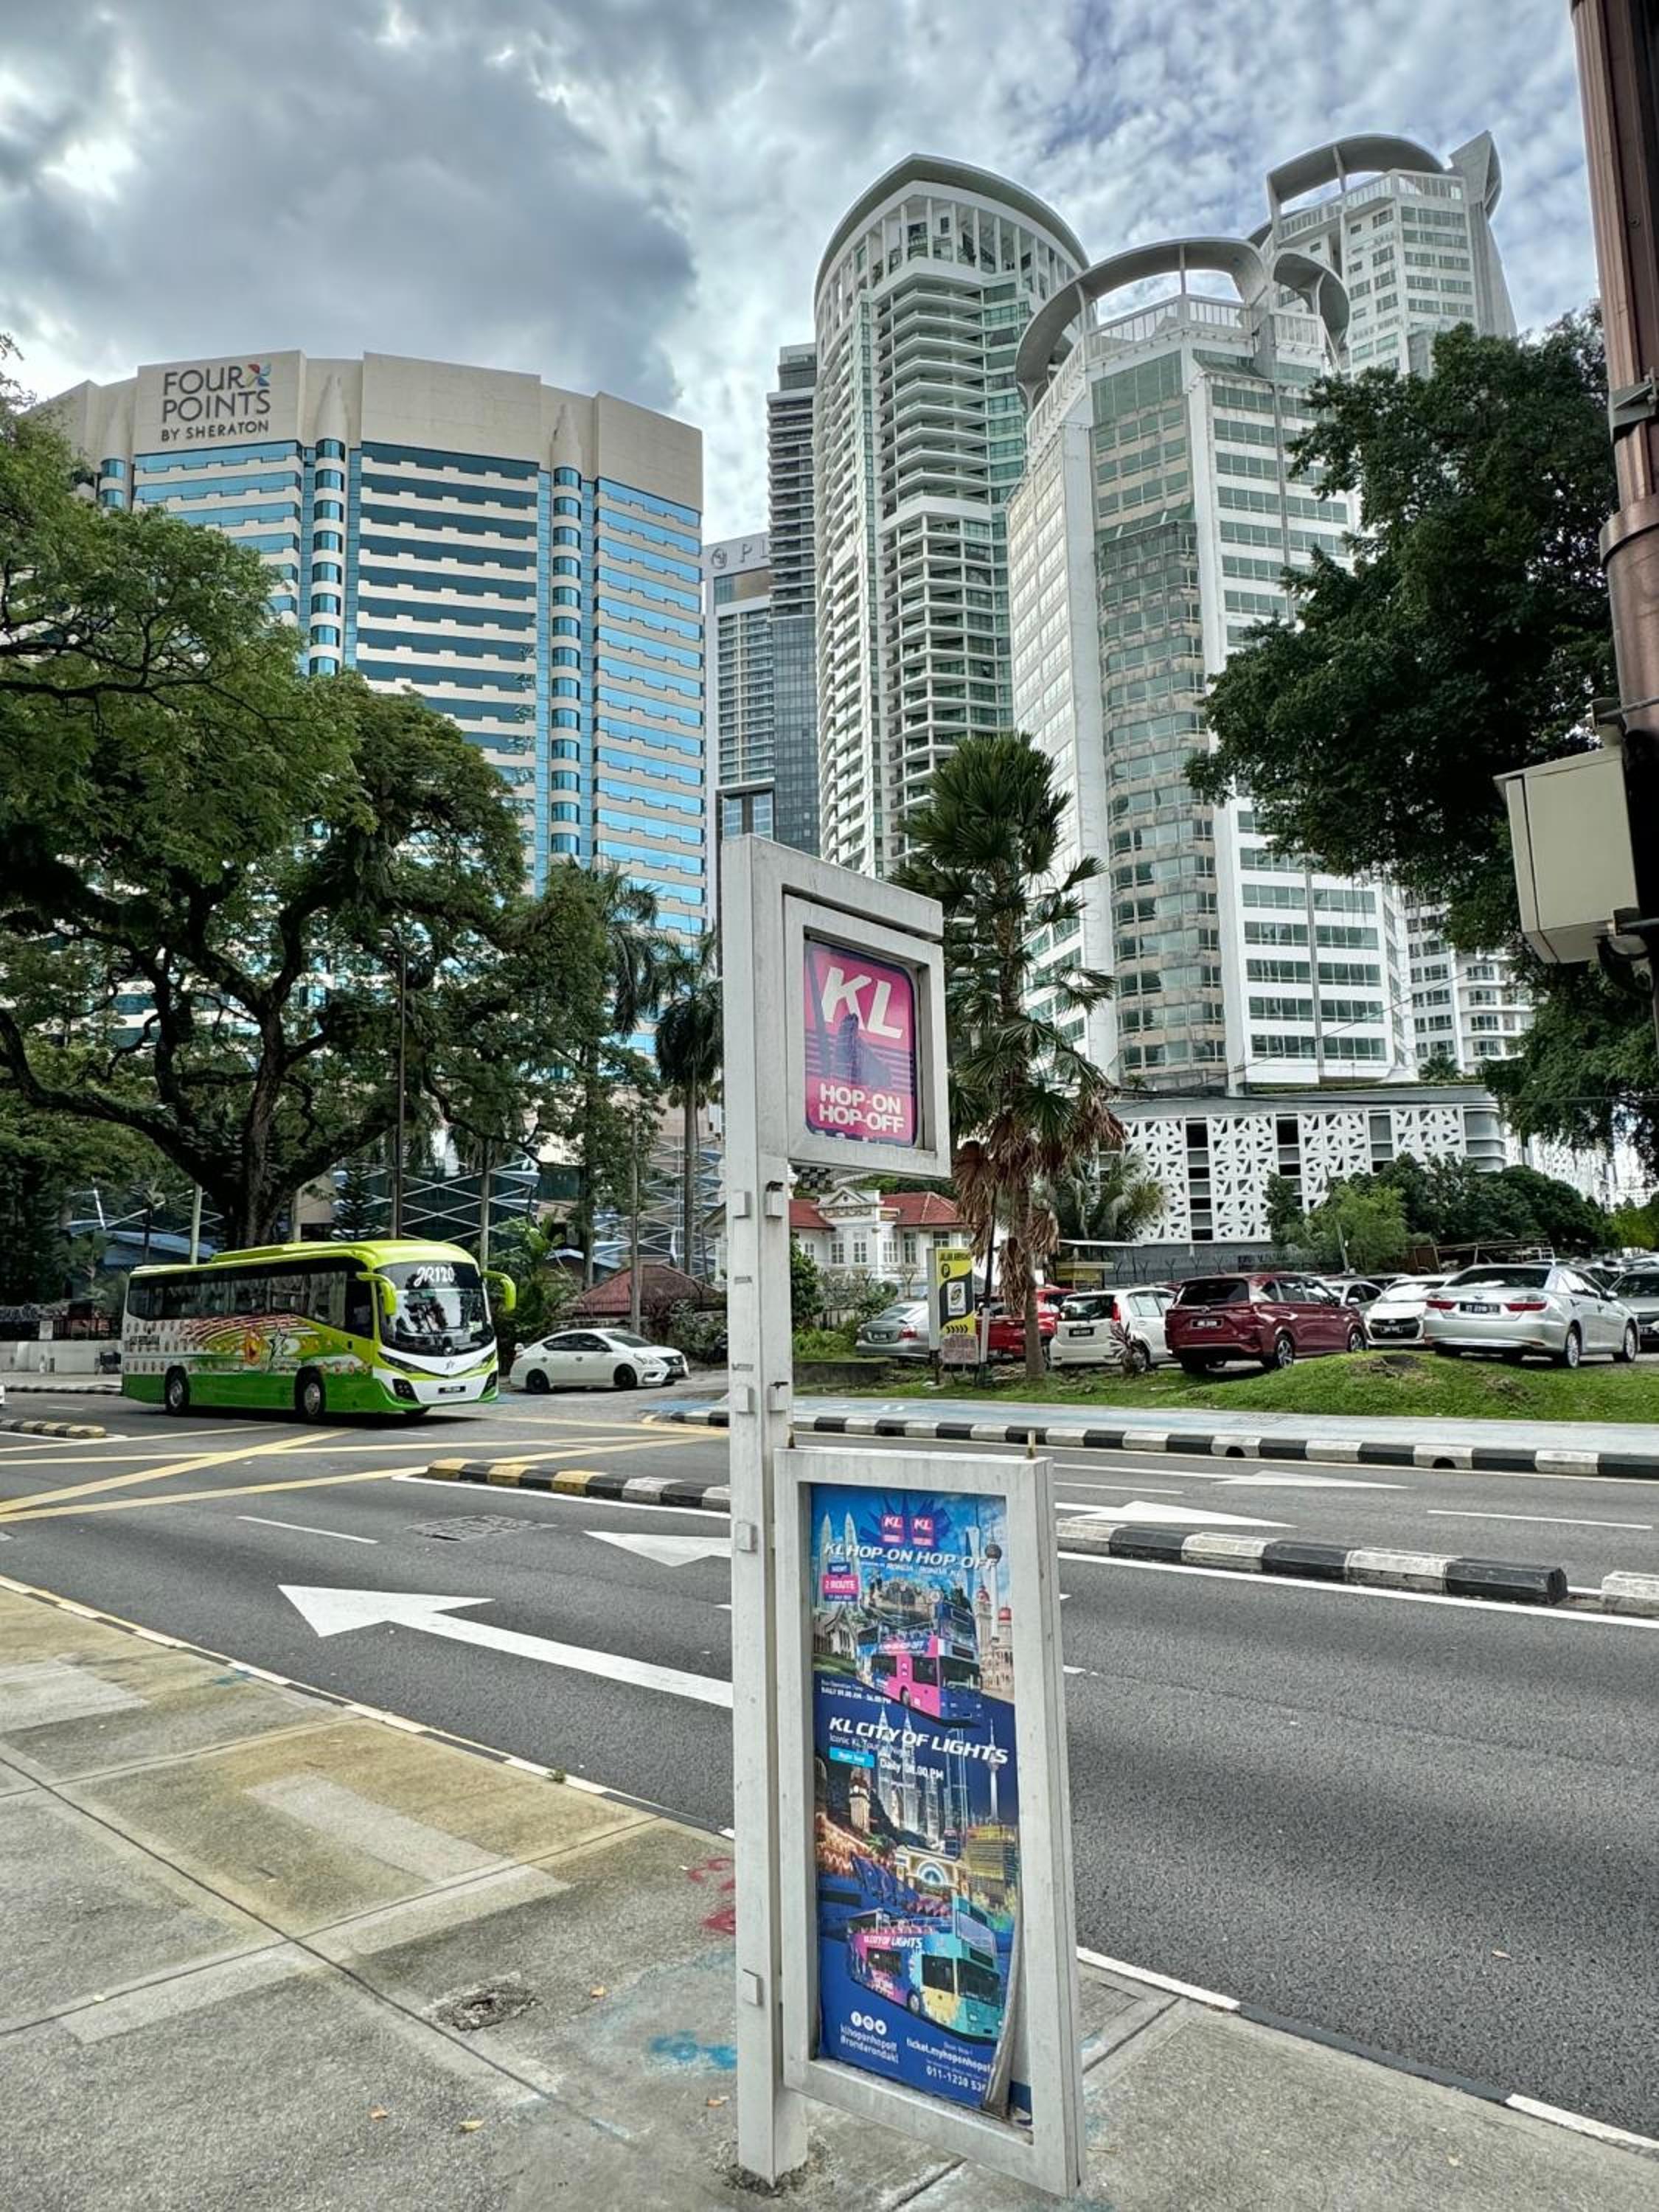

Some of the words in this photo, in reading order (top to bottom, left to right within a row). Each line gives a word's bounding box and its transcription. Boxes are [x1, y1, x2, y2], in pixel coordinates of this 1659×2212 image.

[164, 366, 245, 395] FOUR
[162, 389, 271, 423] POINTS
[161, 429, 180, 442] BY
[187, 420, 269, 439] SHERATON
[821, 967, 903, 1039] KL
[819, 1082, 901, 1115] HOP-ON
[818, 1104, 905, 1133] HOP-OFF
[884, 1516, 902, 1528] KL
[914, 1518, 932, 1530] KL
[824, 1543, 844, 1556] KL
[846, 1544, 914, 1563] HOP-ON
[829, 1717, 854, 1733] KL
[856, 1722, 902, 1742] CITY
[902, 1730, 930, 1747] OF
[931, 1736, 1009, 1764] LIGHTS
